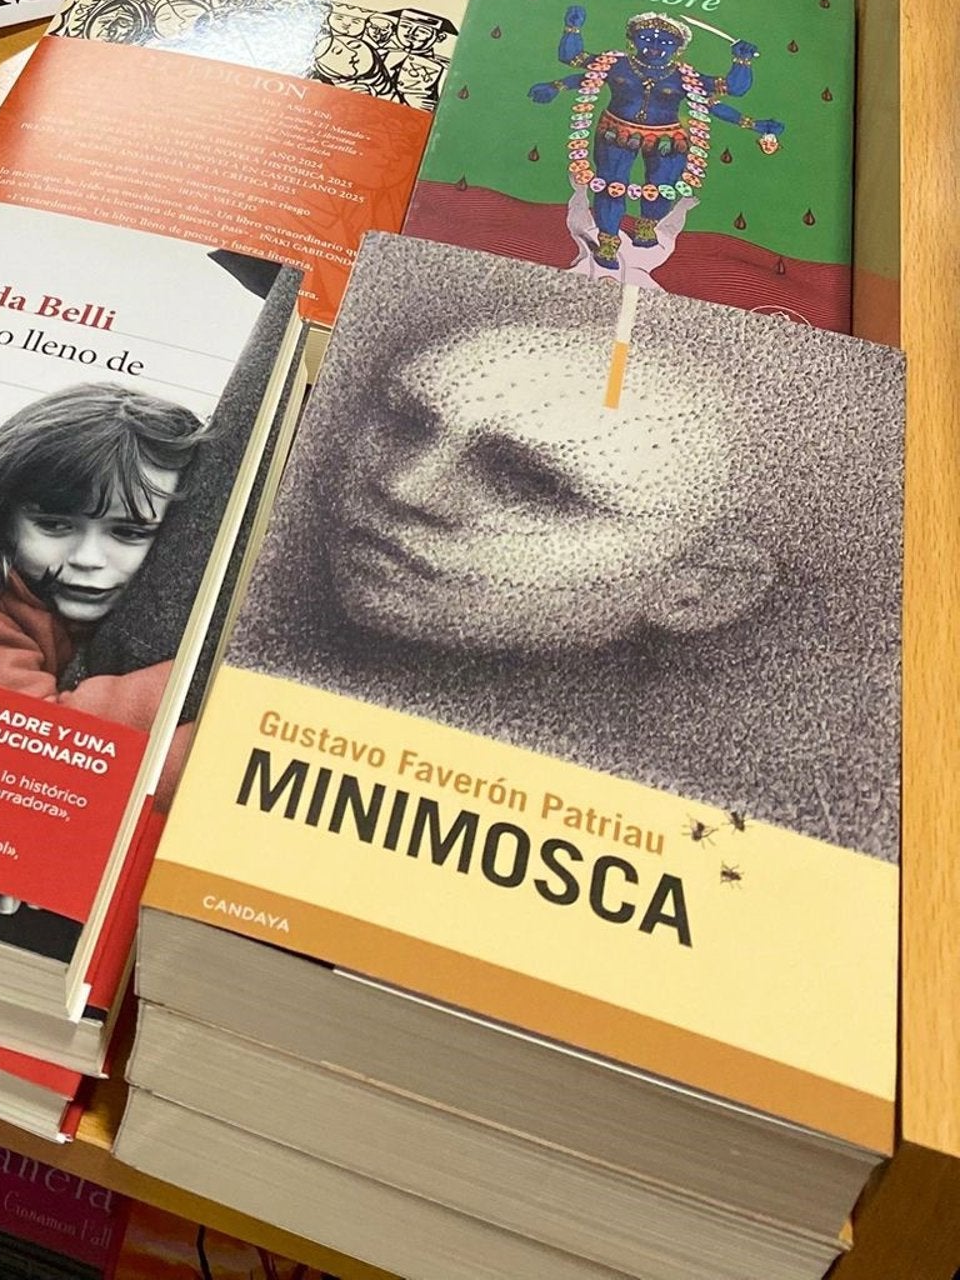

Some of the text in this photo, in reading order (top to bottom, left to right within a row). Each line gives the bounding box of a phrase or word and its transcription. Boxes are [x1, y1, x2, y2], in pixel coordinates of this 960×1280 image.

[260, 170, 337, 196] CASTELLANO
[279, 202, 311, 216] riesgo
[264, 224, 343, 252] extraordinario
[35, 295, 118, 331] Belli
[22, 328, 98, 366] lleno
[105, 351, 146, 377] de
[57, 725, 71, 741] Y
[73, 731, 116, 757] UNA
[1, 770, 16, 785] lo
[20, 775, 87, 808] histórico
[258, 709, 666, 857] Gustavo Faverón Patriau
[235, 747, 693, 949] MINIMOSCA
[201, 894, 291, 935] CANDAYA
